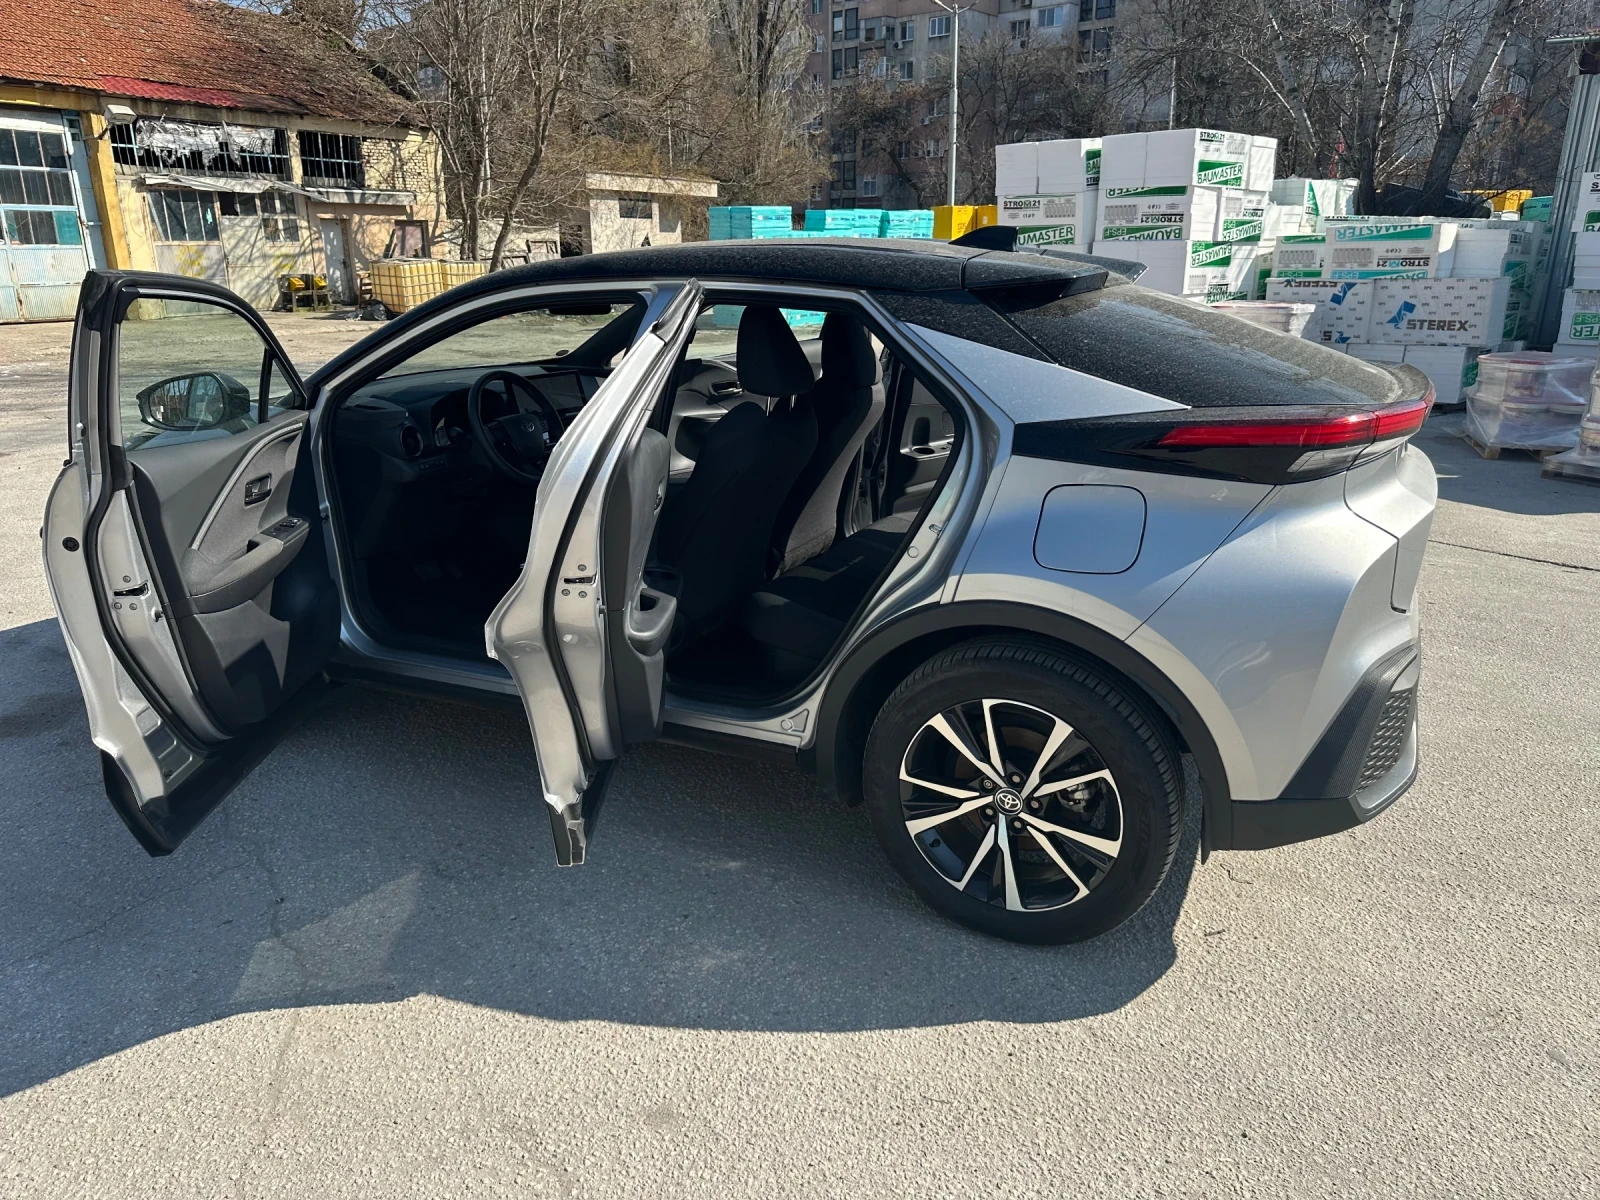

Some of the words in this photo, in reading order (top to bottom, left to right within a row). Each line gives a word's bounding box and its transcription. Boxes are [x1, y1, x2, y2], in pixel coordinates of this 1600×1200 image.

[1198, 163, 1243, 184] BAUMASTER
[1222, 221, 1262, 241] BAUMASTER
[1191, 243, 1232, 266] BAUMASTER
[1406, 319, 1469, 331] STEREX
